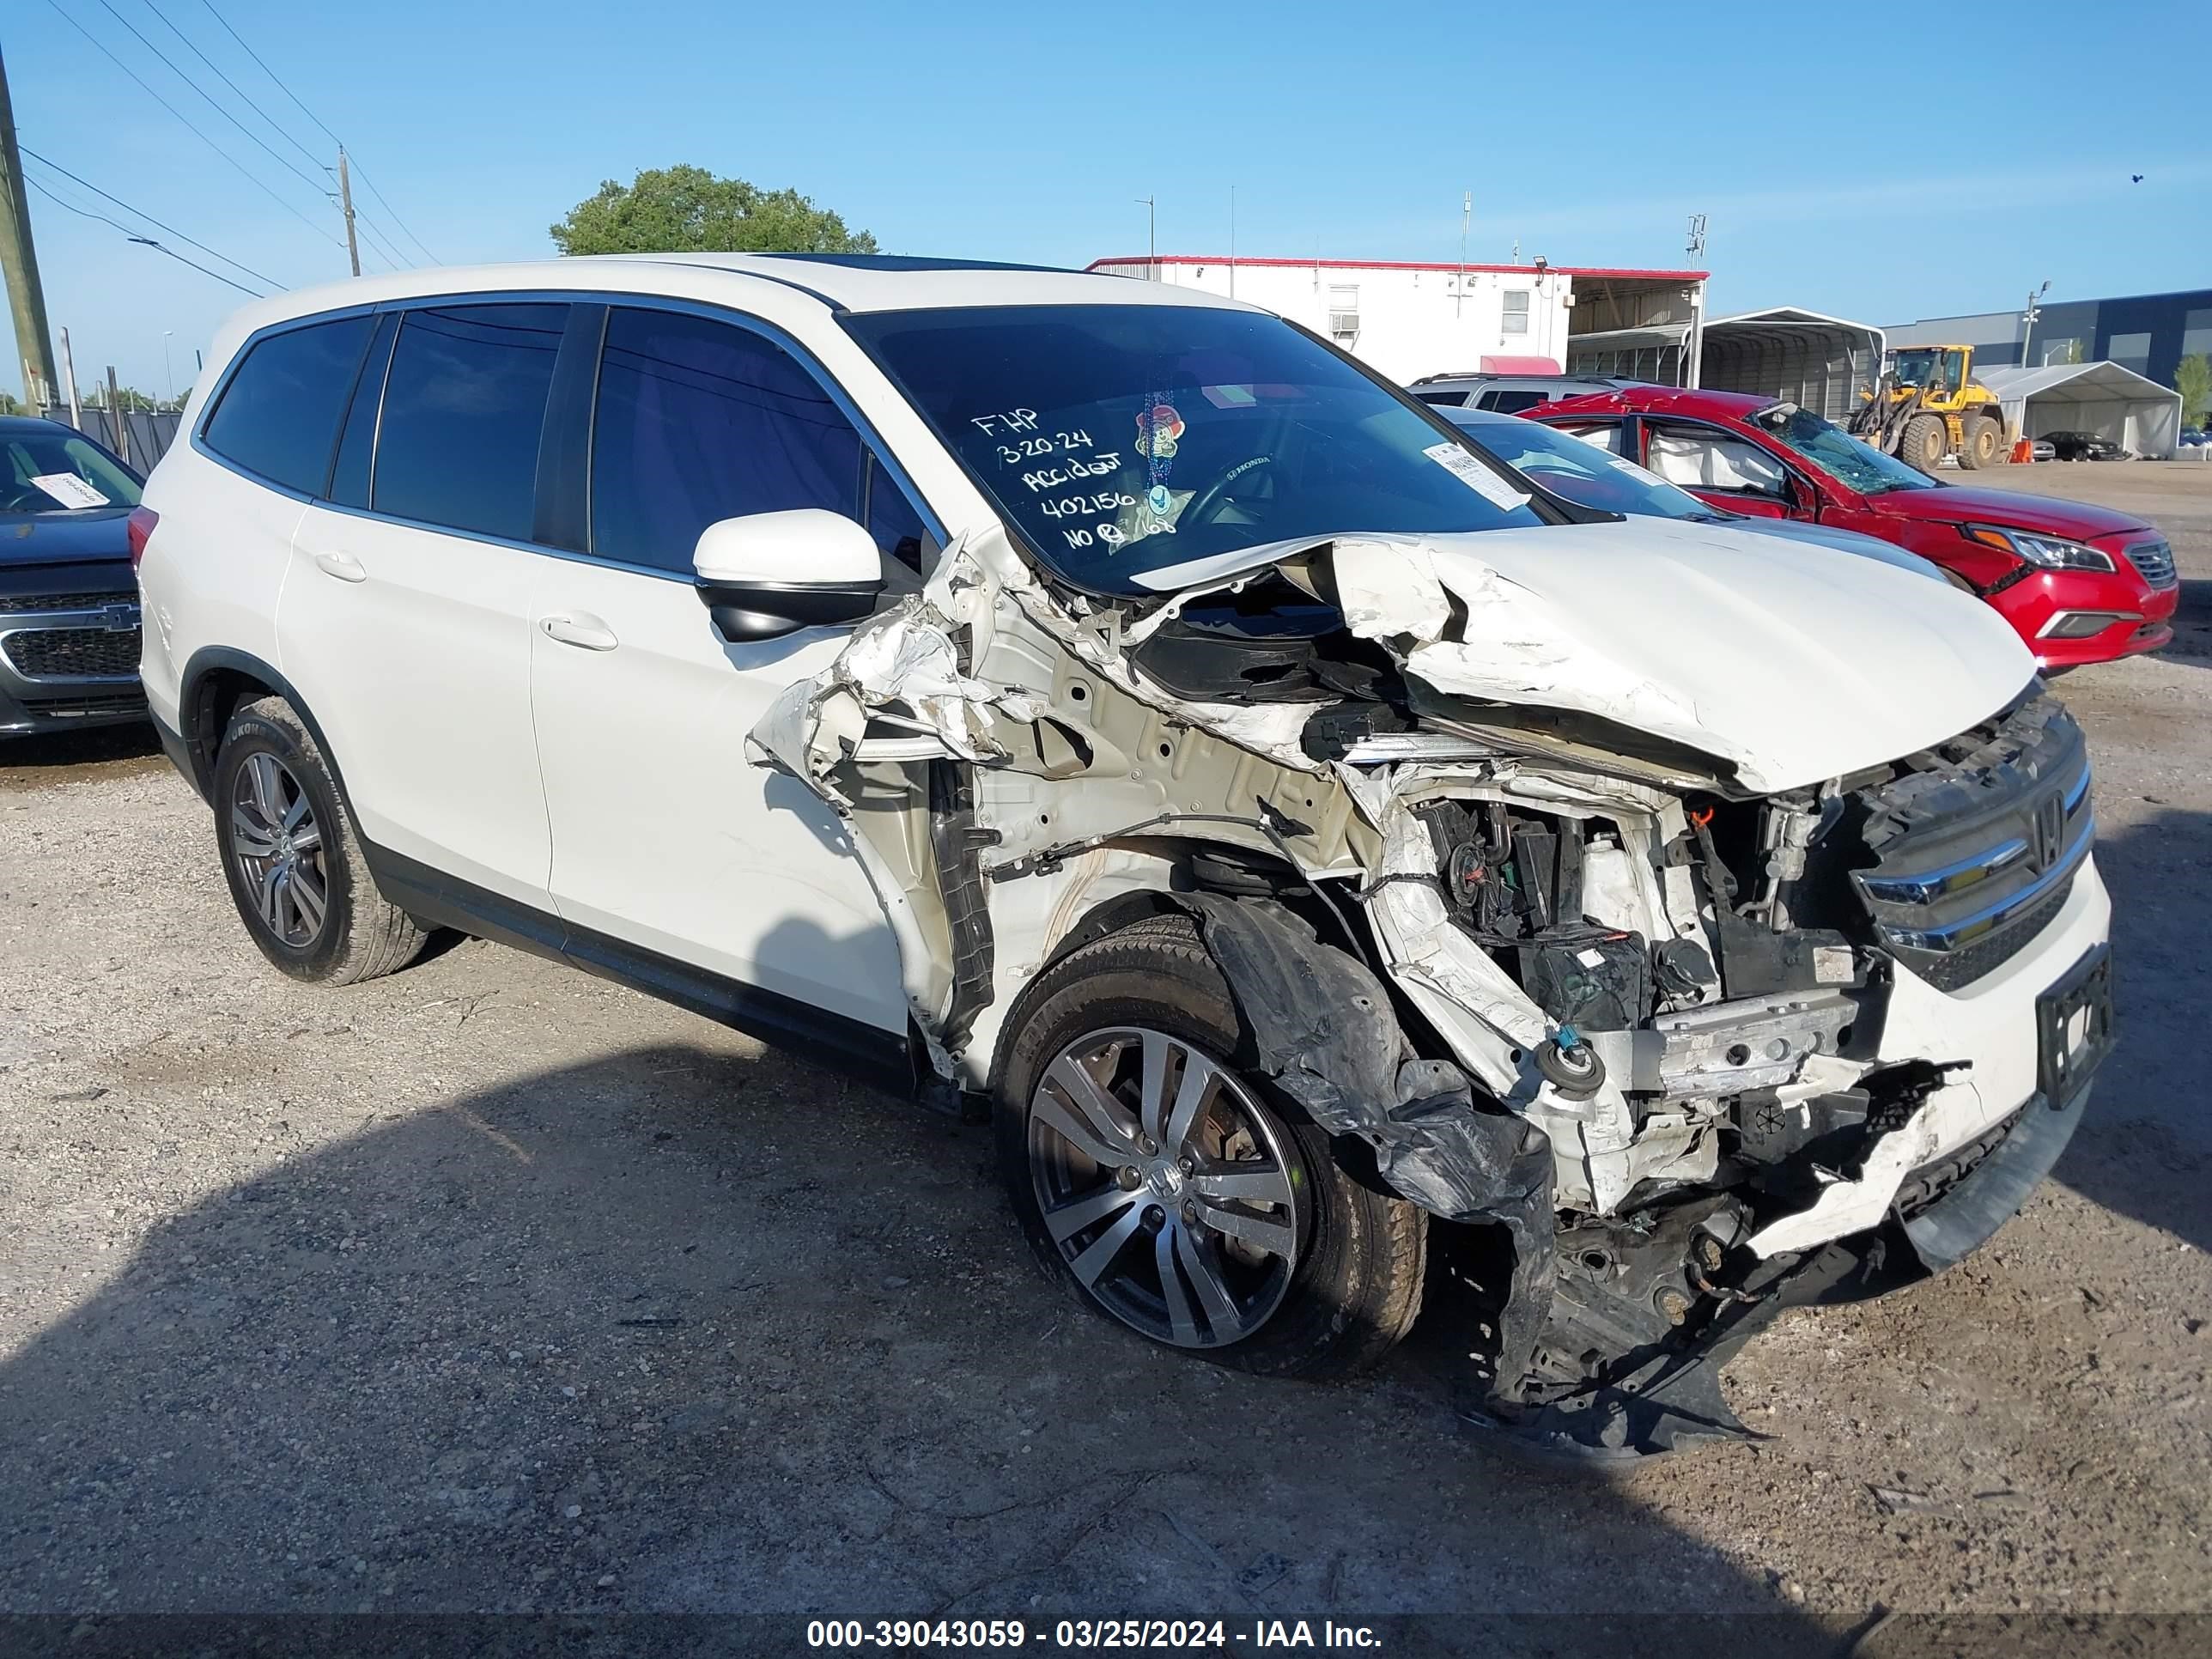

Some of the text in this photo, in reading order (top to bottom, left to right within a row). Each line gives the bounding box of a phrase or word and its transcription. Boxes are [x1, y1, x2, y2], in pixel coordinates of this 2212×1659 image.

[996, 428, 1094, 464] 3-20-24
[1236, 457, 1271, 473] HONDA
[1041, 492, 1136, 518] 402156
[1062, 529, 1093, 550] NO
